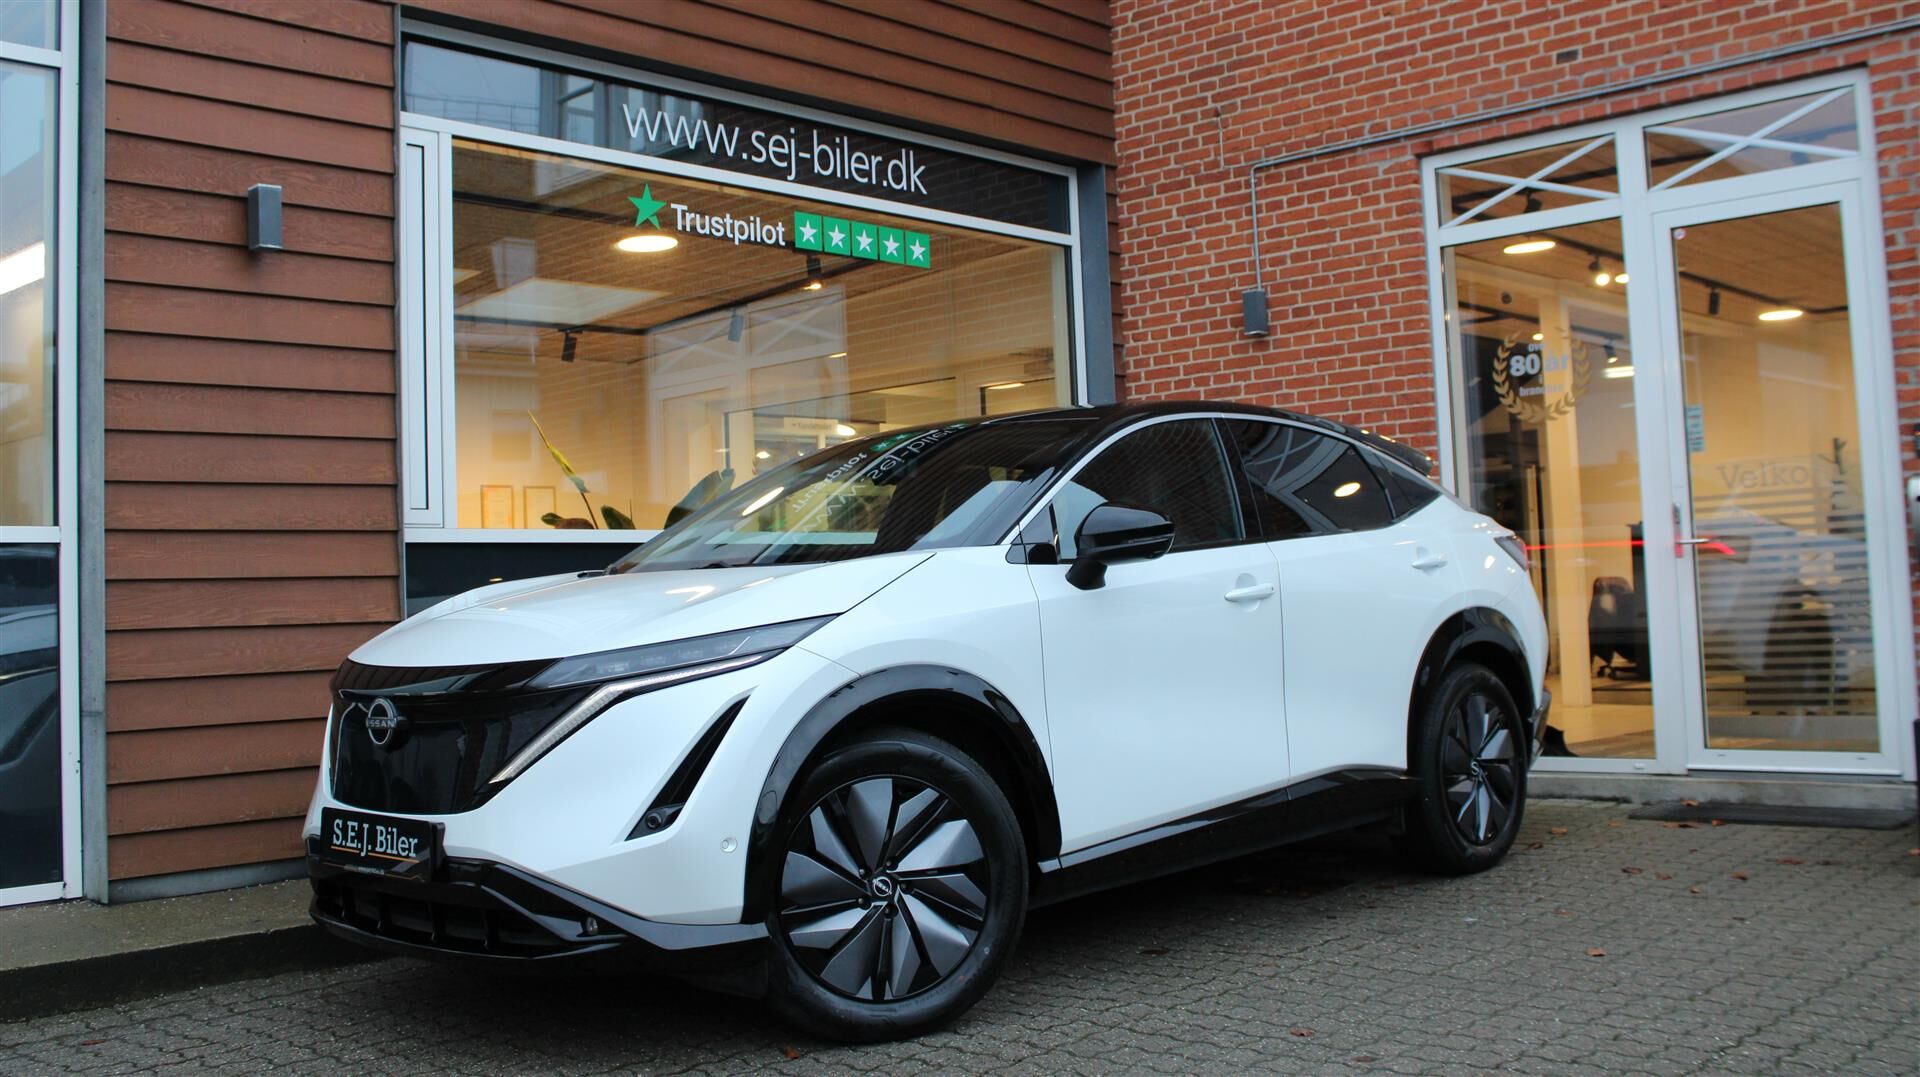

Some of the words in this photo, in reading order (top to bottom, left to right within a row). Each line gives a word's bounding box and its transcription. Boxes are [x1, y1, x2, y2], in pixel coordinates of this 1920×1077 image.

[623, 103, 928, 195] www.sej-biler.dk
[671, 203, 786, 247] Trustpilot
[1509, 353, 1541, 377] 80
[333, 819, 371, 857] S.E.J.
[375, 825, 418, 858] Biler
